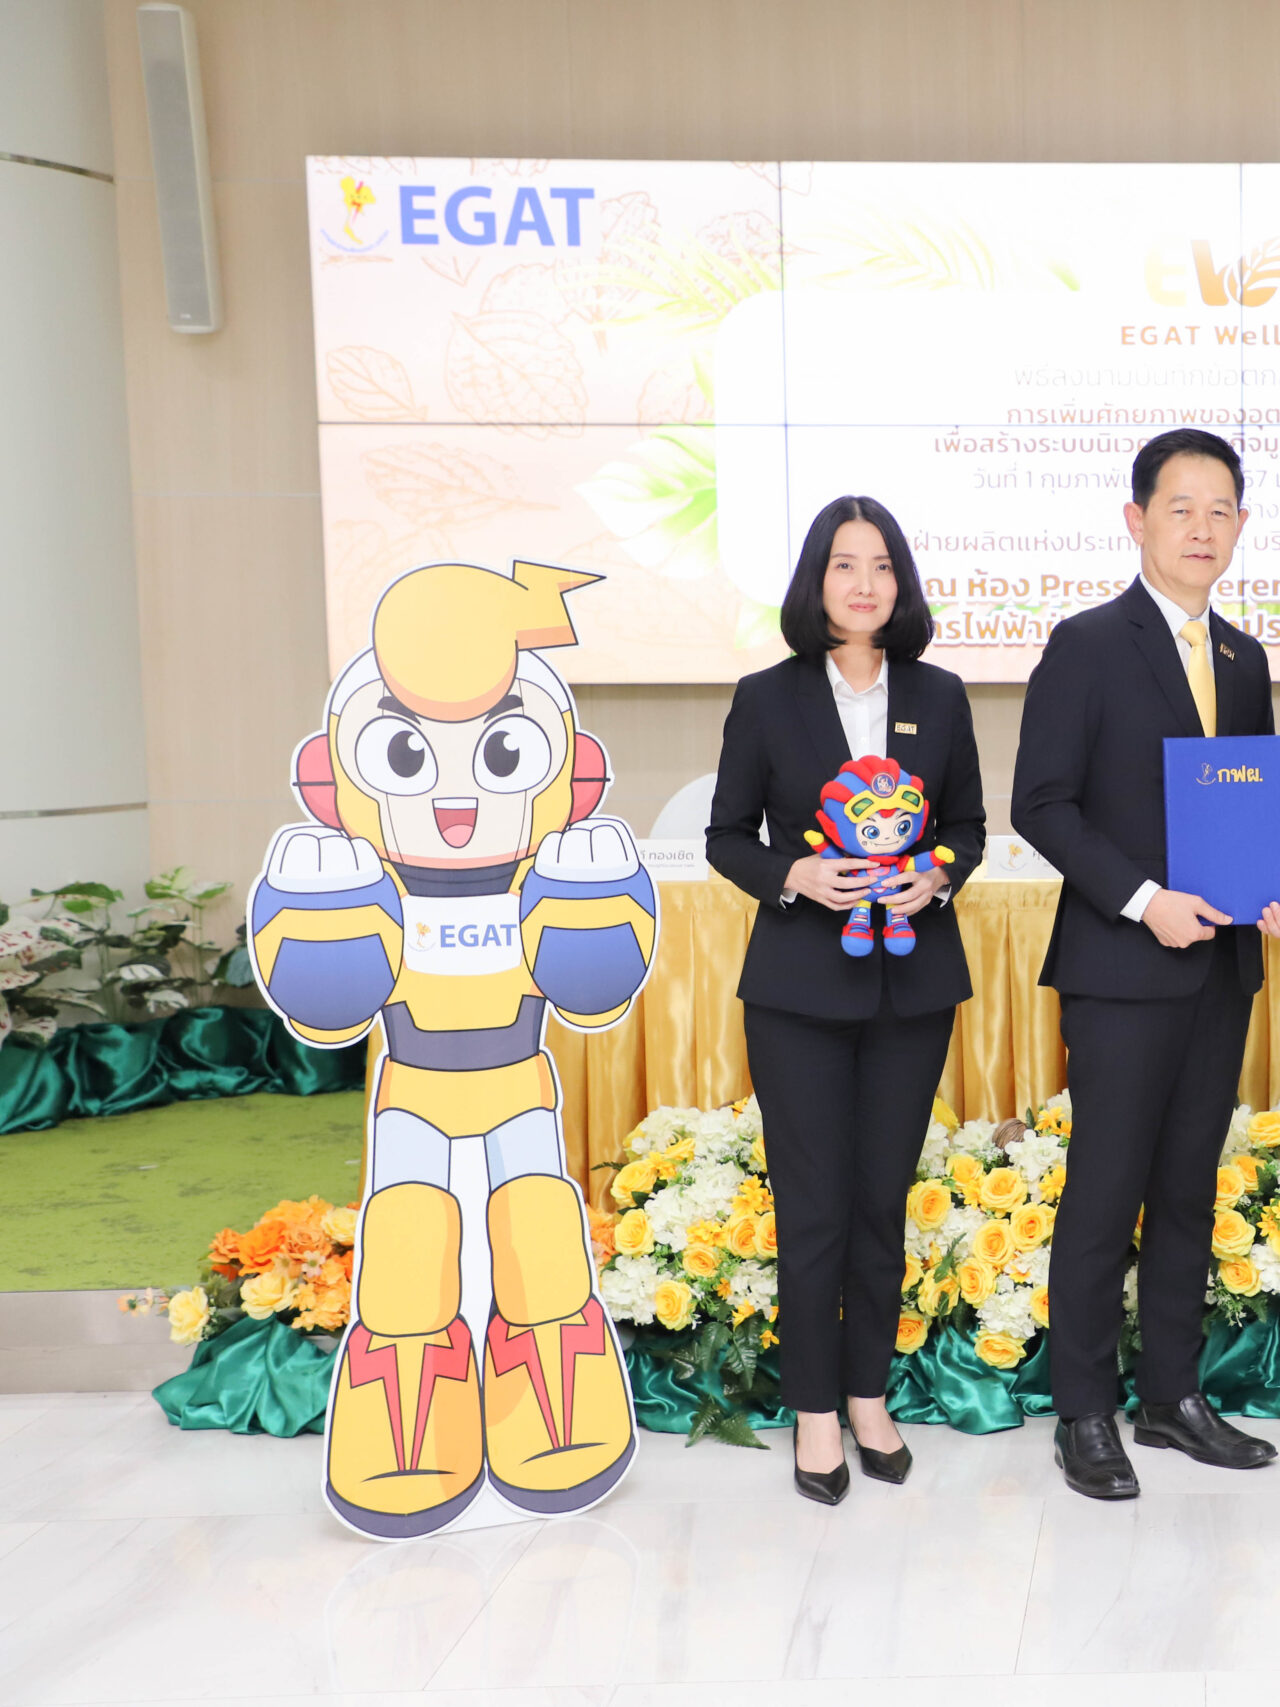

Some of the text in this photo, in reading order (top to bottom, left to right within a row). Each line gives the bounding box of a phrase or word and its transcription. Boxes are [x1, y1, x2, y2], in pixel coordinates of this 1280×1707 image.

[399, 185, 595, 247] EGAT
[1120, 325, 1201, 346] EGAT
[973, 462, 1018, 489] วันที่
[967, 568, 1030, 598] ห้อง
[1040, 574, 1128, 598] Press
[1217, 764, 1264, 783] กฟผ.
[439, 922, 518, 949] EGAT
